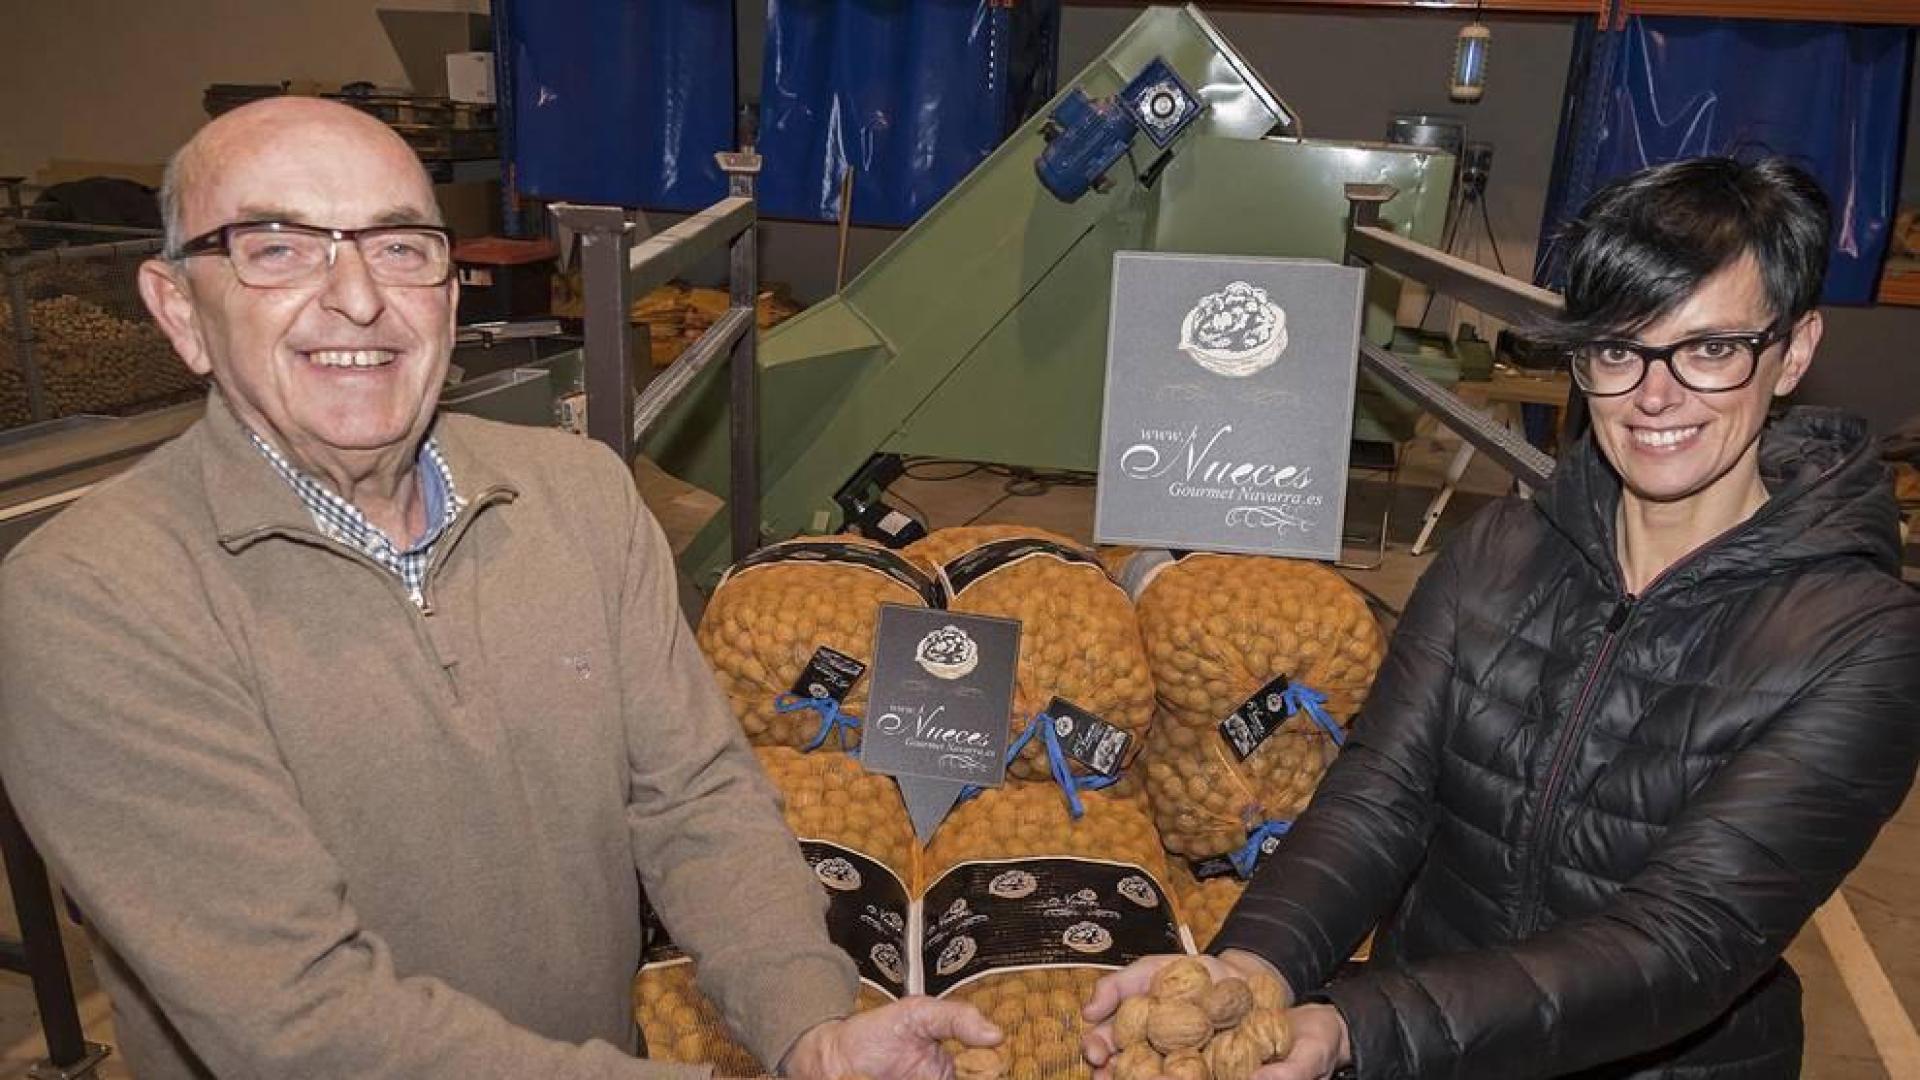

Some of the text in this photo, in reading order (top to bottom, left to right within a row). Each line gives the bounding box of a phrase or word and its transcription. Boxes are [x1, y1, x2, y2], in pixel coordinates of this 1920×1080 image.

[1120, 424, 1312, 489] Nueces
[1168, 481, 1323, 505] Gourmet Navarra.es
[876, 702, 990, 747] Nueces
